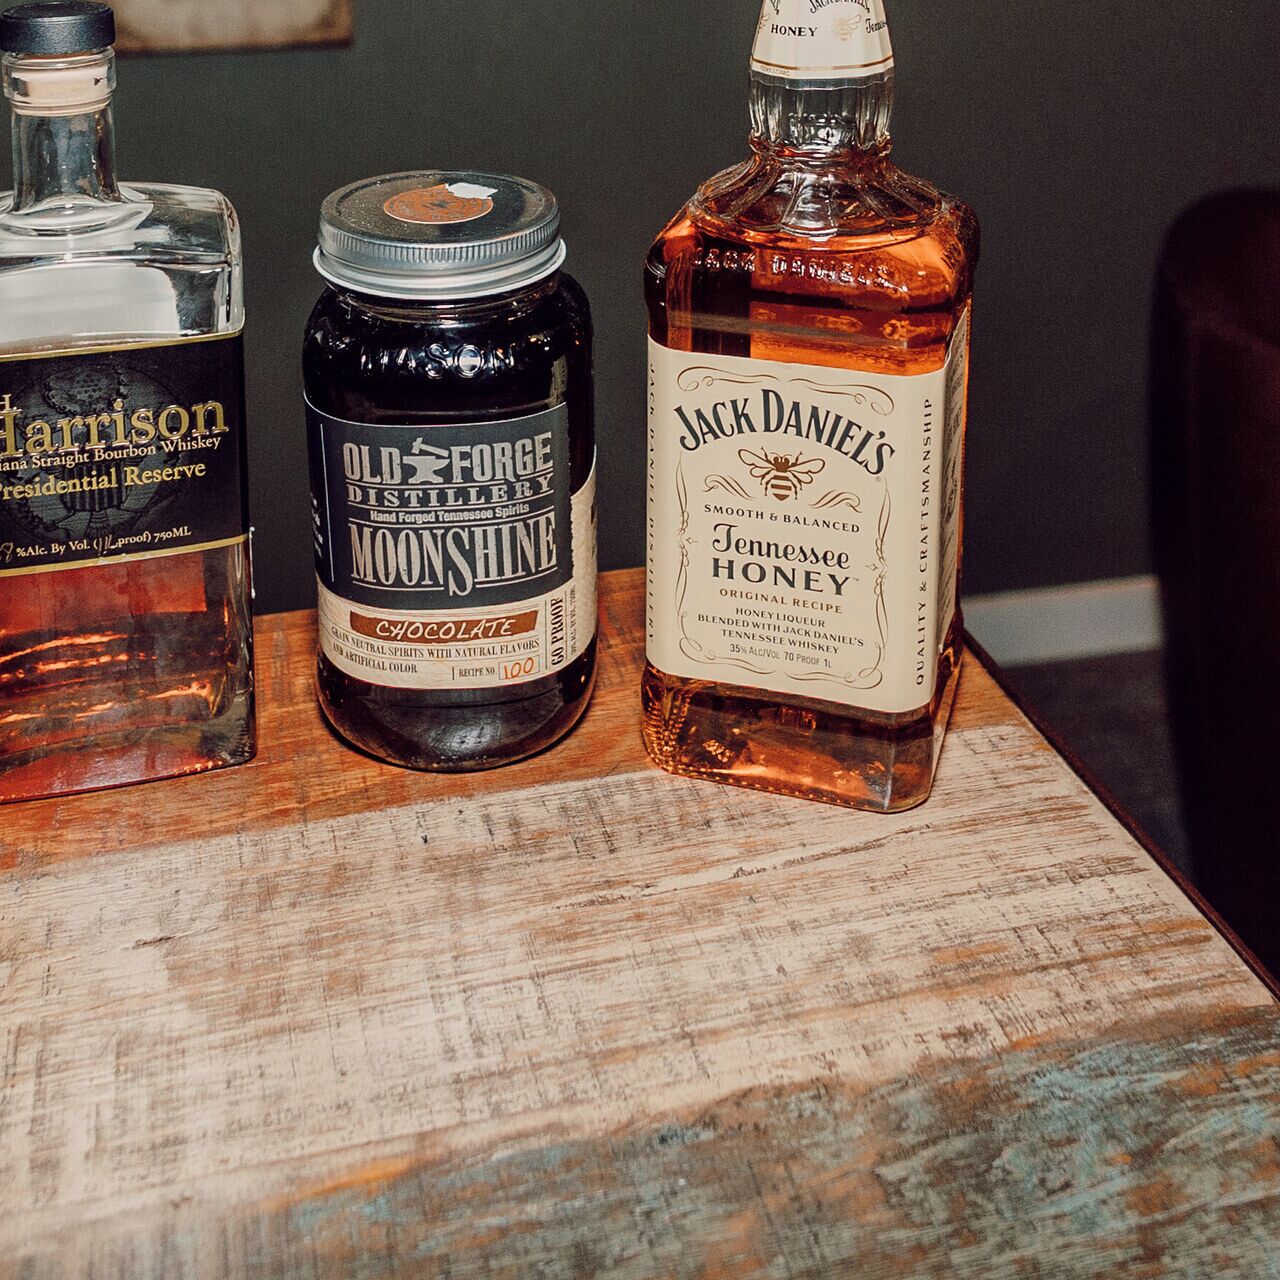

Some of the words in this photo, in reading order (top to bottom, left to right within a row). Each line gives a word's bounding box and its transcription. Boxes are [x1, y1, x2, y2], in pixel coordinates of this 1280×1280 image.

[770, 23, 818, 37] HONEY
[673, 397, 757, 452] JACK
[761, 388, 896, 476] DANIEL'S
[31, 451, 89, 468] Straight
[94, 444, 156, 461] Bourbon
[160, 435, 222, 453] Whiskey
[342, 441, 403, 483] OLD
[450, 431, 553, 483] FORGE
[123, 462, 207, 487] Reserve
[919, 398, 933, 573] CRAFTSMANSHIP
[347, 473, 554, 507] DISTILLERY
[371, 510, 396, 522] Hand
[399, 511, 435, 523] Forged
[437, 508, 493, 521] Tennessee
[495, 503, 530, 519] Spirits
[704, 504, 764, 520] SMOOTH
[769, 512, 778, 521] &
[783, 514, 860, 533] BALANCED
[51, 543, 67, 557] By
[69, 540, 91, 551] Vol.
[154, 526, 192, 543] 750ML
[349, 512, 558, 596] MOONSHINE
[712, 523, 851, 570] Tennessee
[712, 557, 850, 596] HONEY
[919, 581, 927, 593] &
[720, 588, 787, 604] ORIGINAL
[792, 598, 842, 614] RECIPE
[376, 619, 517, 641] CHOCOLATE
[698, 614, 749, 628] BLENDED
[752, 622, 781, 632] WITH
[783, 627, 811, 638] JACK
[813, 632, 864, 646] DANIEL'S
[735, 607, 773, 619] HONEY
[776, 613, 826, 628] LIQUEUR
[351, 636, 387, 655] NEUTRAL
[388, 646, 424, 658] SPIRITS
[427, 648, 452, 658] WITH
[454, 644, 498, 658] NATURAL
[499, 638, 540, 654] FLAVORS
[721, 629, 788, 645] TENNESSEE
[788, 638, 840, 654] WHISKEY
[916, 601, 927, 686] QUALITY
[345, 651, 387, 671] ARTIFICIAL
[388, 662, 418, 674] COLOR
[458, 667, 484, 678] RECIPE
[503, 657, 535, 680] 100
[730, 643, 748, 654] 35%
[784, 651, 794, 661] 70
[824, 659, 832, 668] 1L
